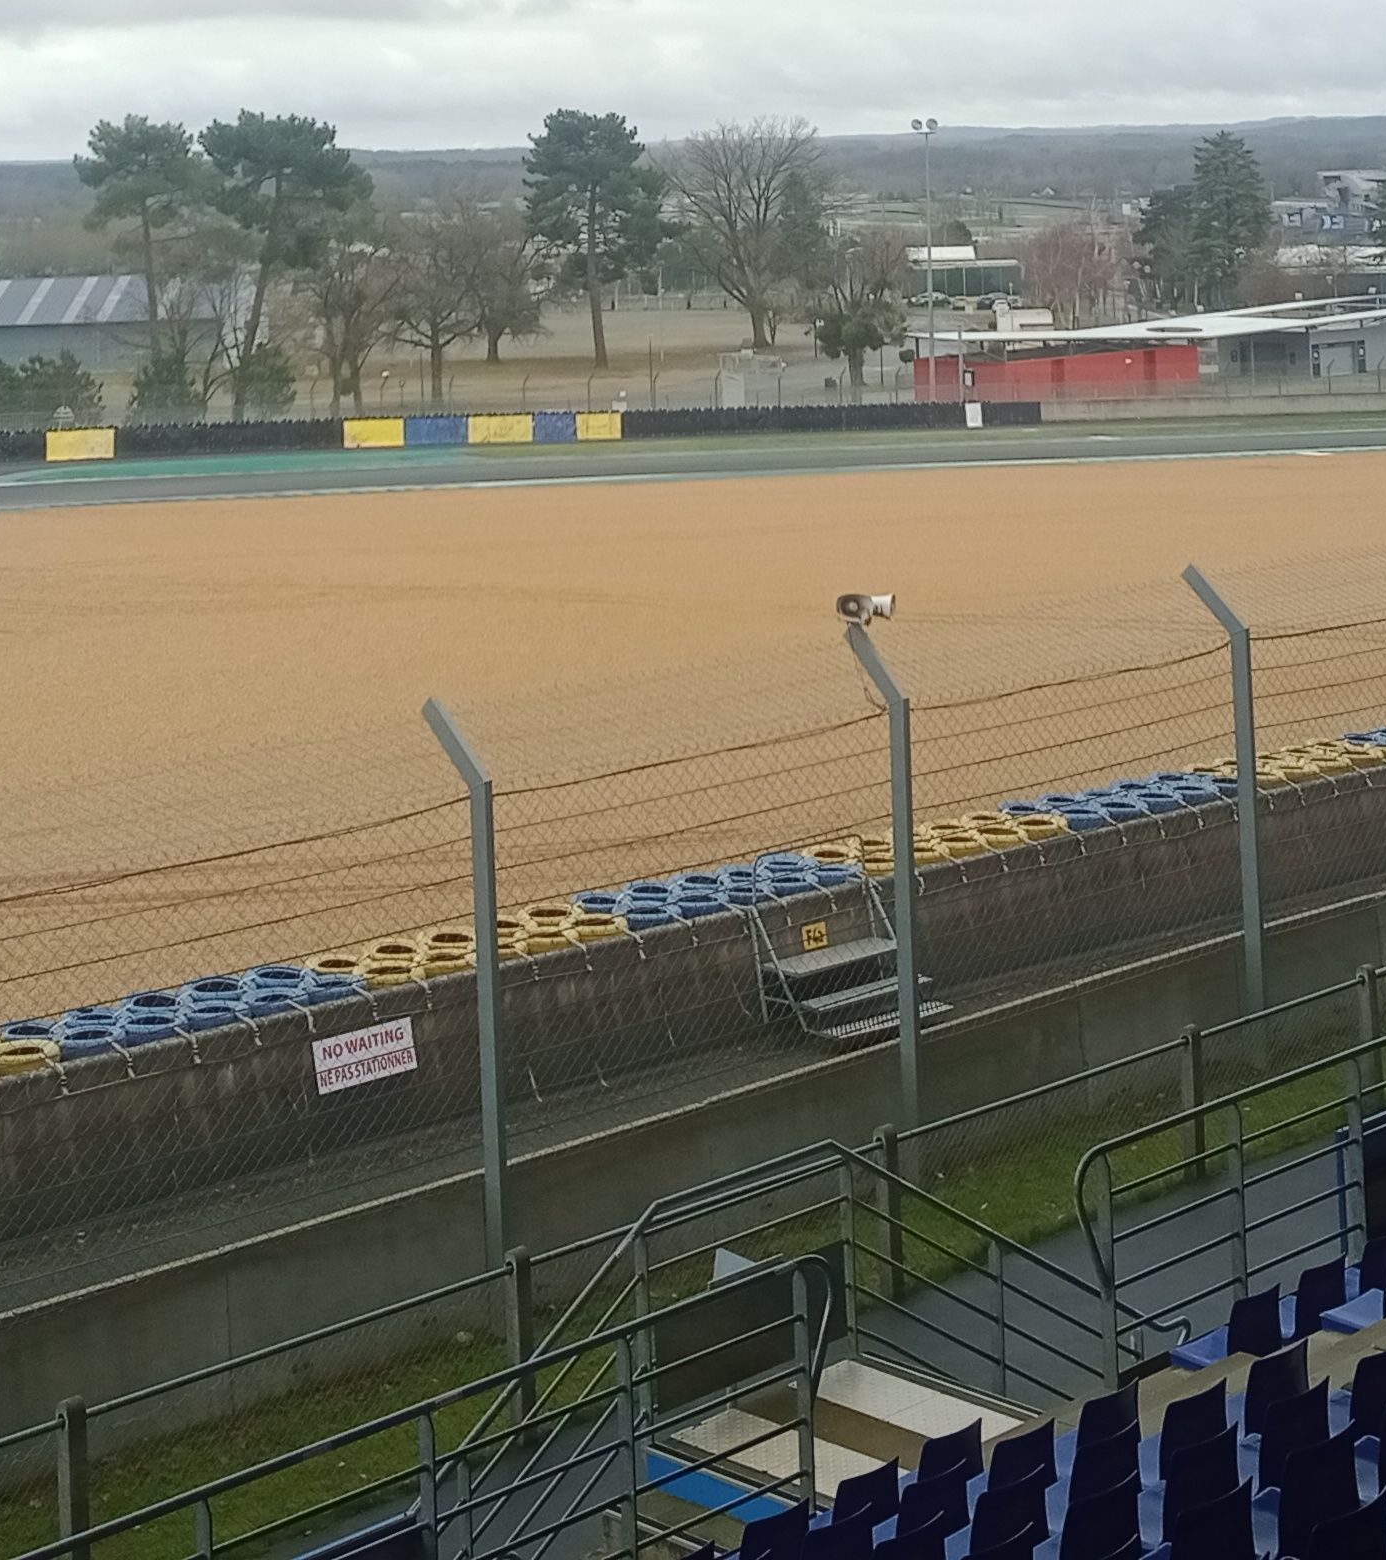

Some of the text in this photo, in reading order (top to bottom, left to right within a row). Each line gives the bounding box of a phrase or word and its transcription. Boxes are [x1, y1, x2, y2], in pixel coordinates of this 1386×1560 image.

[322, 1027, 404, 1060] NO WAITING
[320, 1050, 413, 1087] NE PAS STATIONNER
